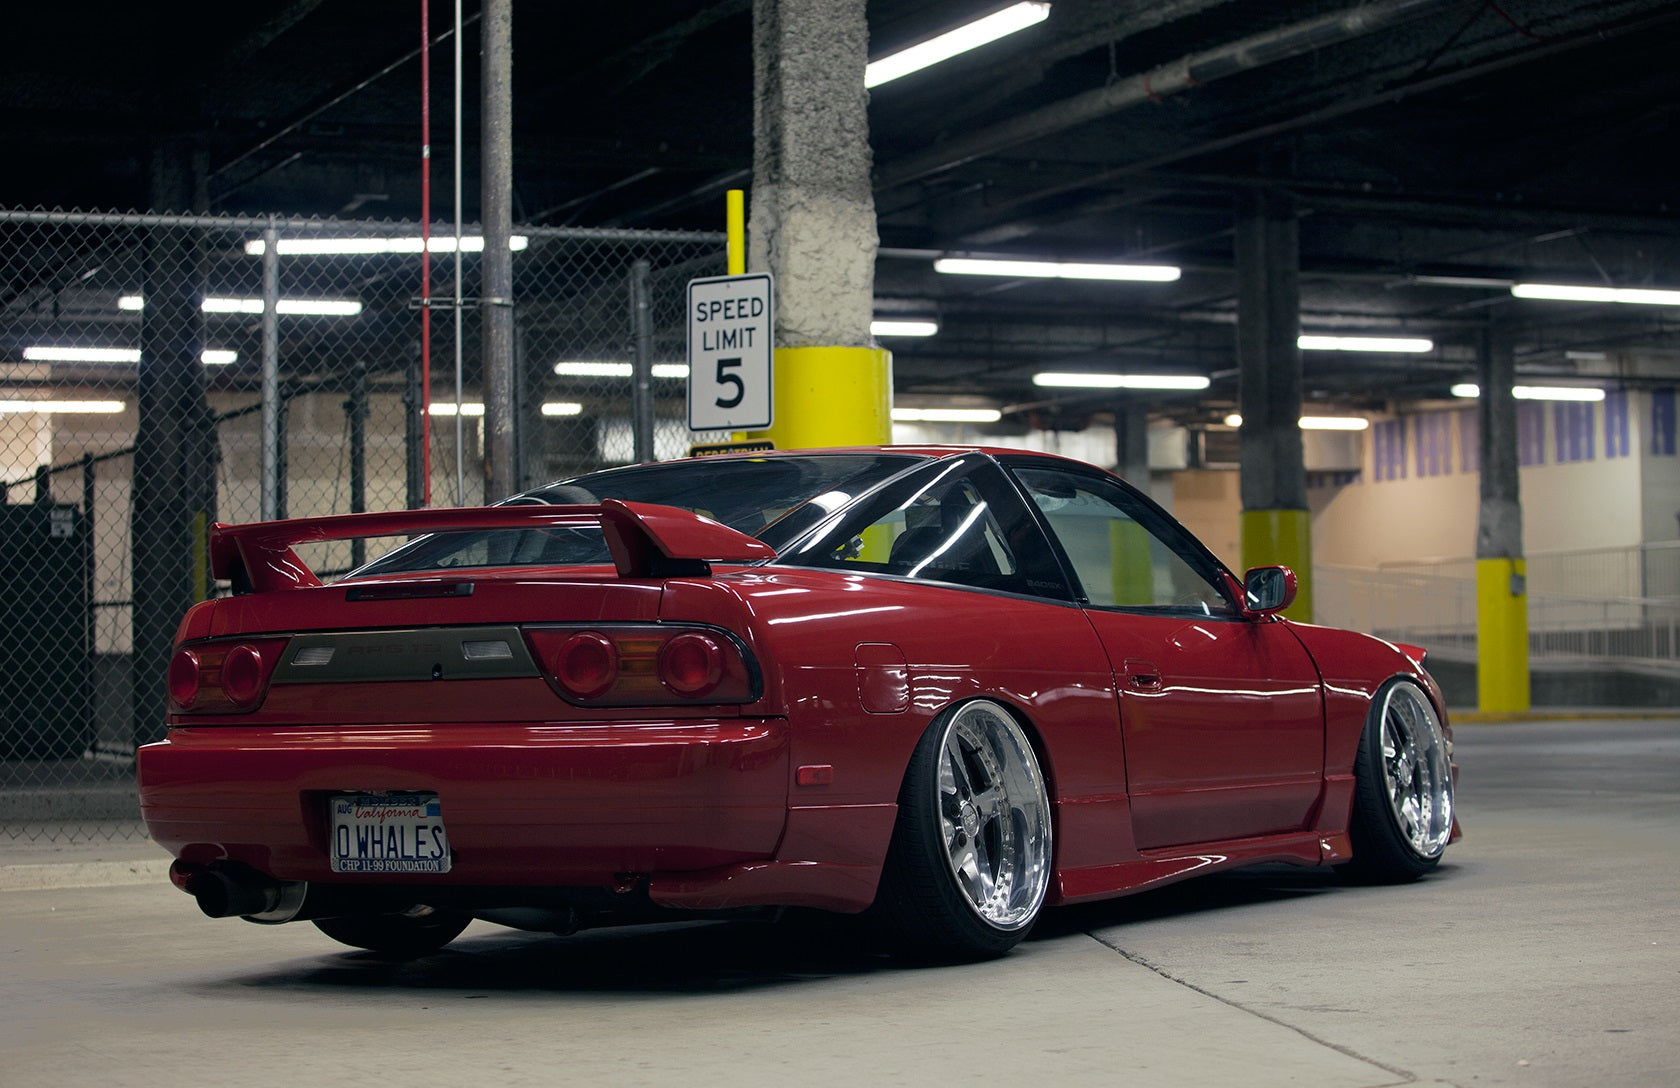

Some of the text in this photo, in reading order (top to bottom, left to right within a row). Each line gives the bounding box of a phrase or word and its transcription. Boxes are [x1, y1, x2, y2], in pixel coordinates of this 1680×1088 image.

[696, 297, 764, 322] SPEED
[703, 327, 756, 351] LIMIT
[715, 357, 745, 409] 5
[337, 804, 352, 814] AUG
[355, 807, 428, 825] California
[340, 860, 439, 872] CHP 11-99 FOUNDATION
